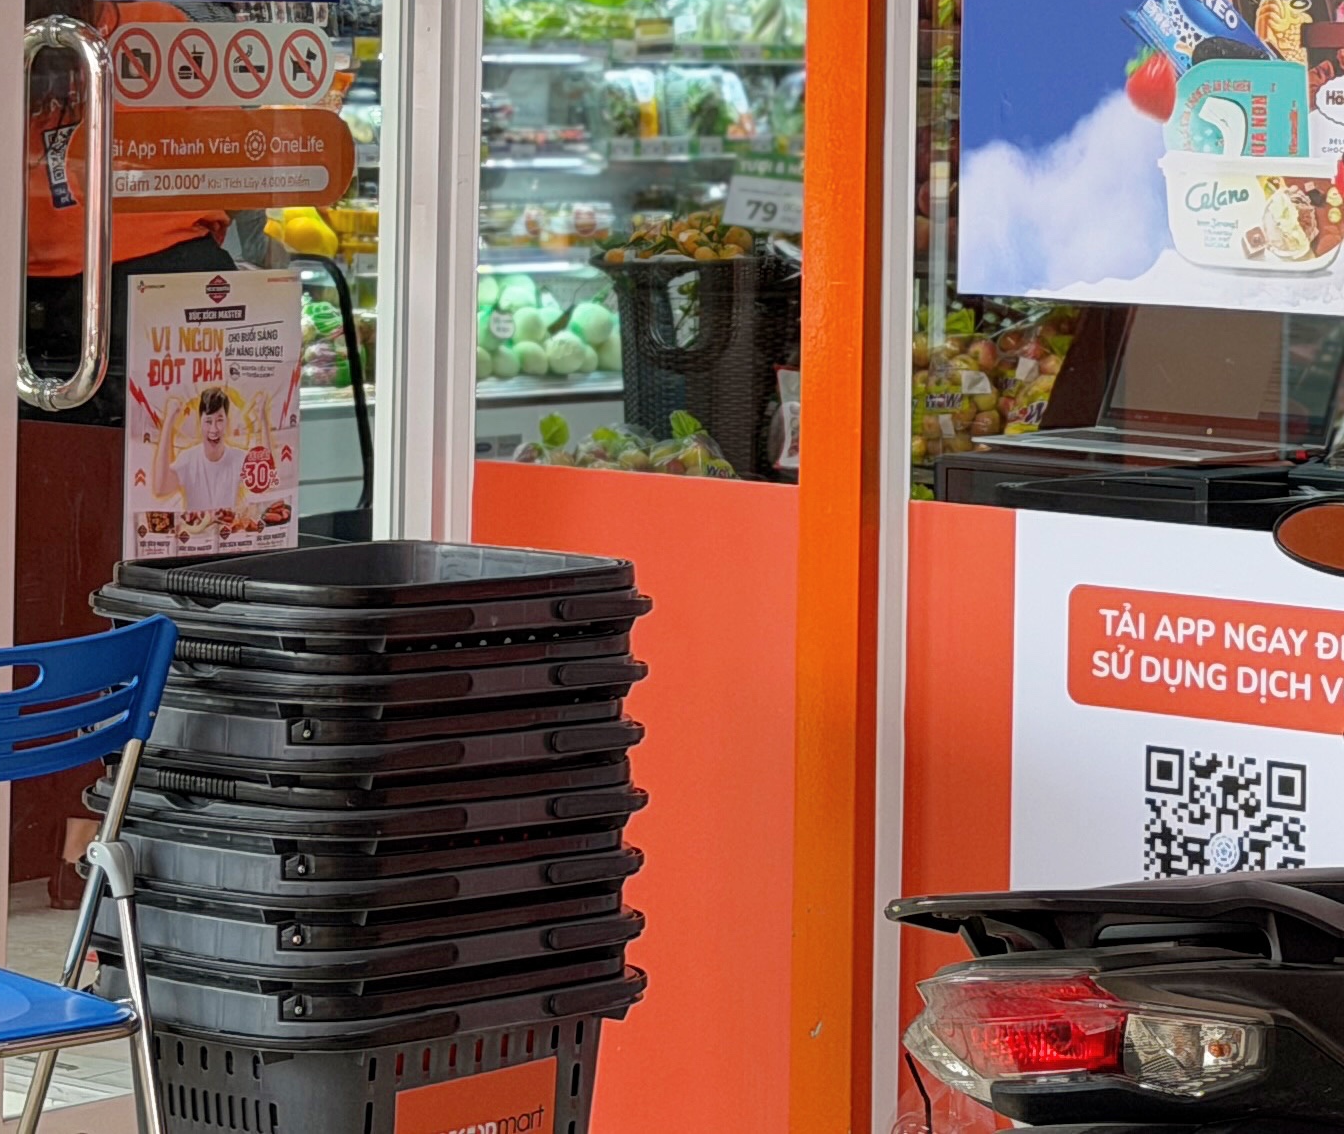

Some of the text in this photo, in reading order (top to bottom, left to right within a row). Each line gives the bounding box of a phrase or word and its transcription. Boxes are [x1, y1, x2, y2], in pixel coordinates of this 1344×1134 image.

[128, 135, 324, 159] App Thành Viên OneLife
[744, 198, 777, 223] 79
[1185, 181, 1249, 212] Celano
[1099, 603, 1146, 640] TẢI
[1154, 615, 1215, 645] APP
[1224, 622, 1308, 656] NGAY
[1091, 644, 1133, 679] SỬ
[1140, 655, 1227, 694] DỤNG
[1237, 665, 1311, 704] DỊCH
